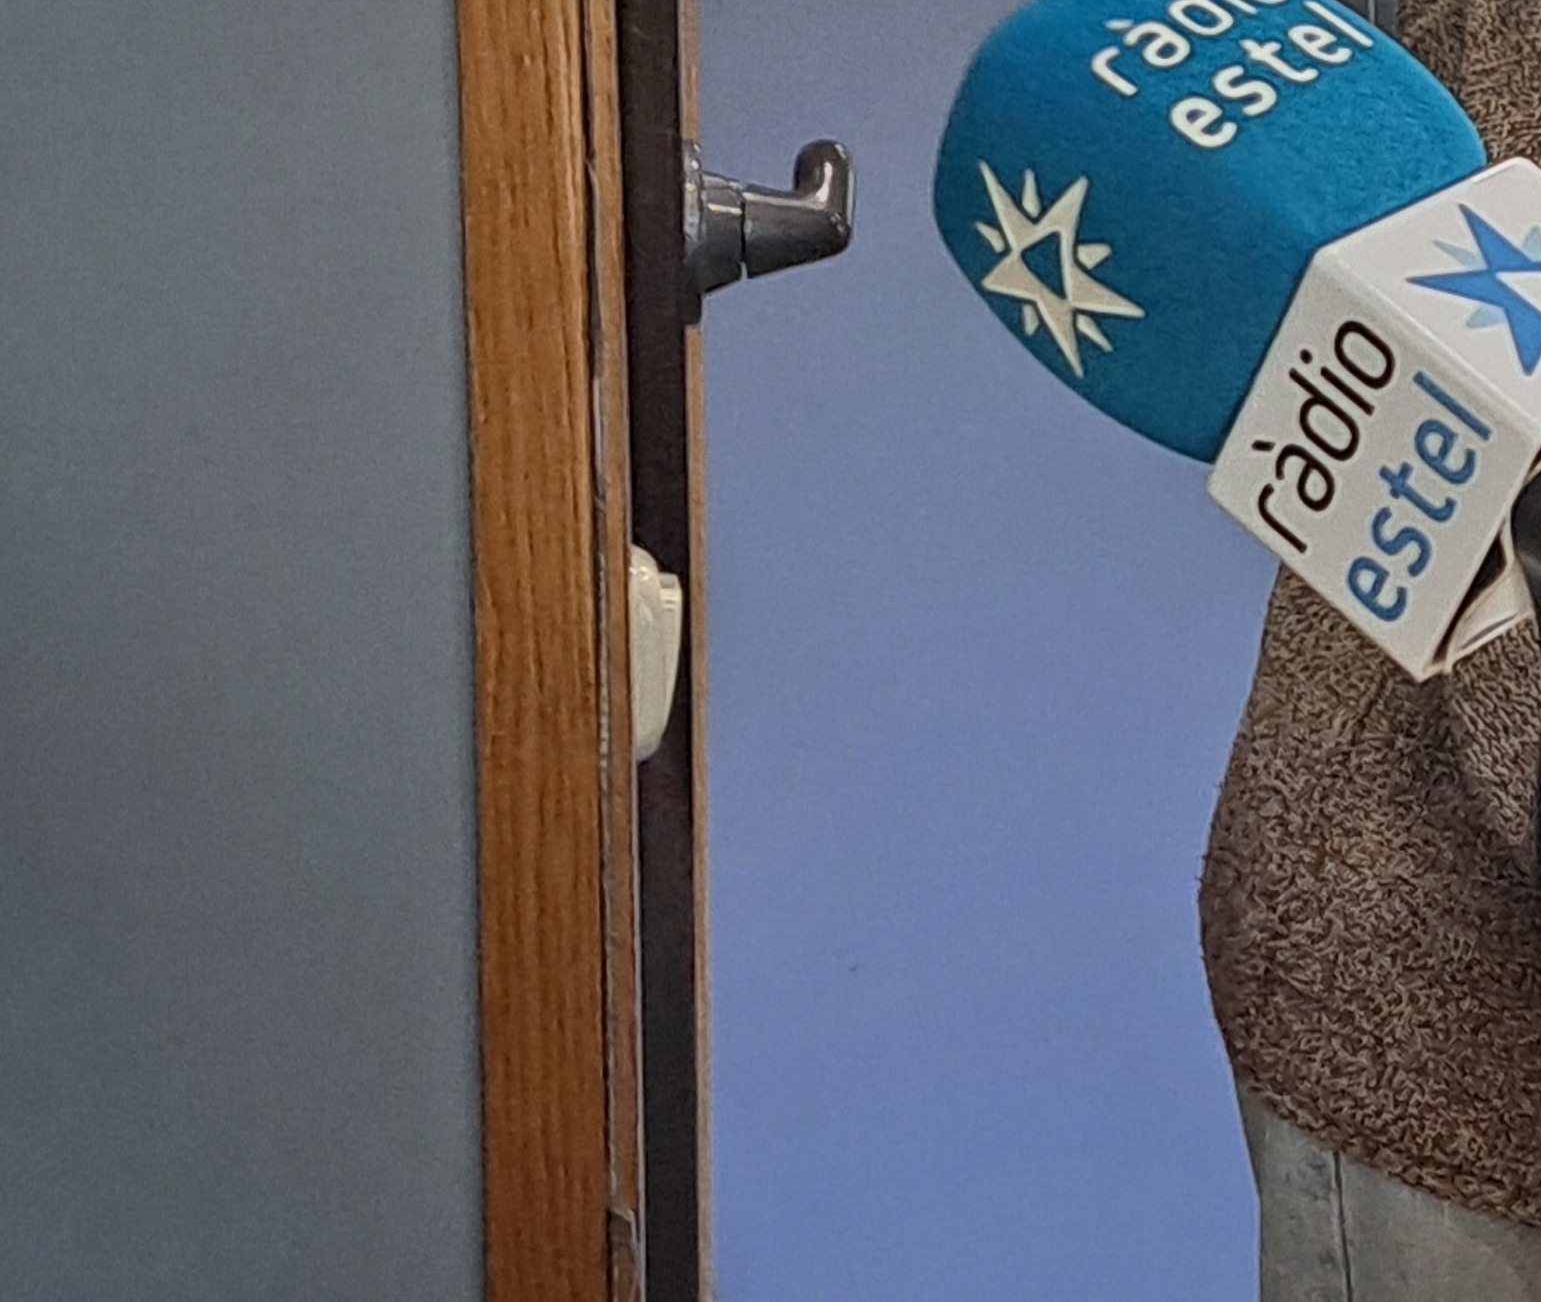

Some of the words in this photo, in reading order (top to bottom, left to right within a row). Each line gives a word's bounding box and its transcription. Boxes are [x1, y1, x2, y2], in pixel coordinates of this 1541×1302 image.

[1169, 0, 1375, 149] estel
[1251, 320, 1396, 555] ràdio
[1346, 370, 1493, 623] estel
